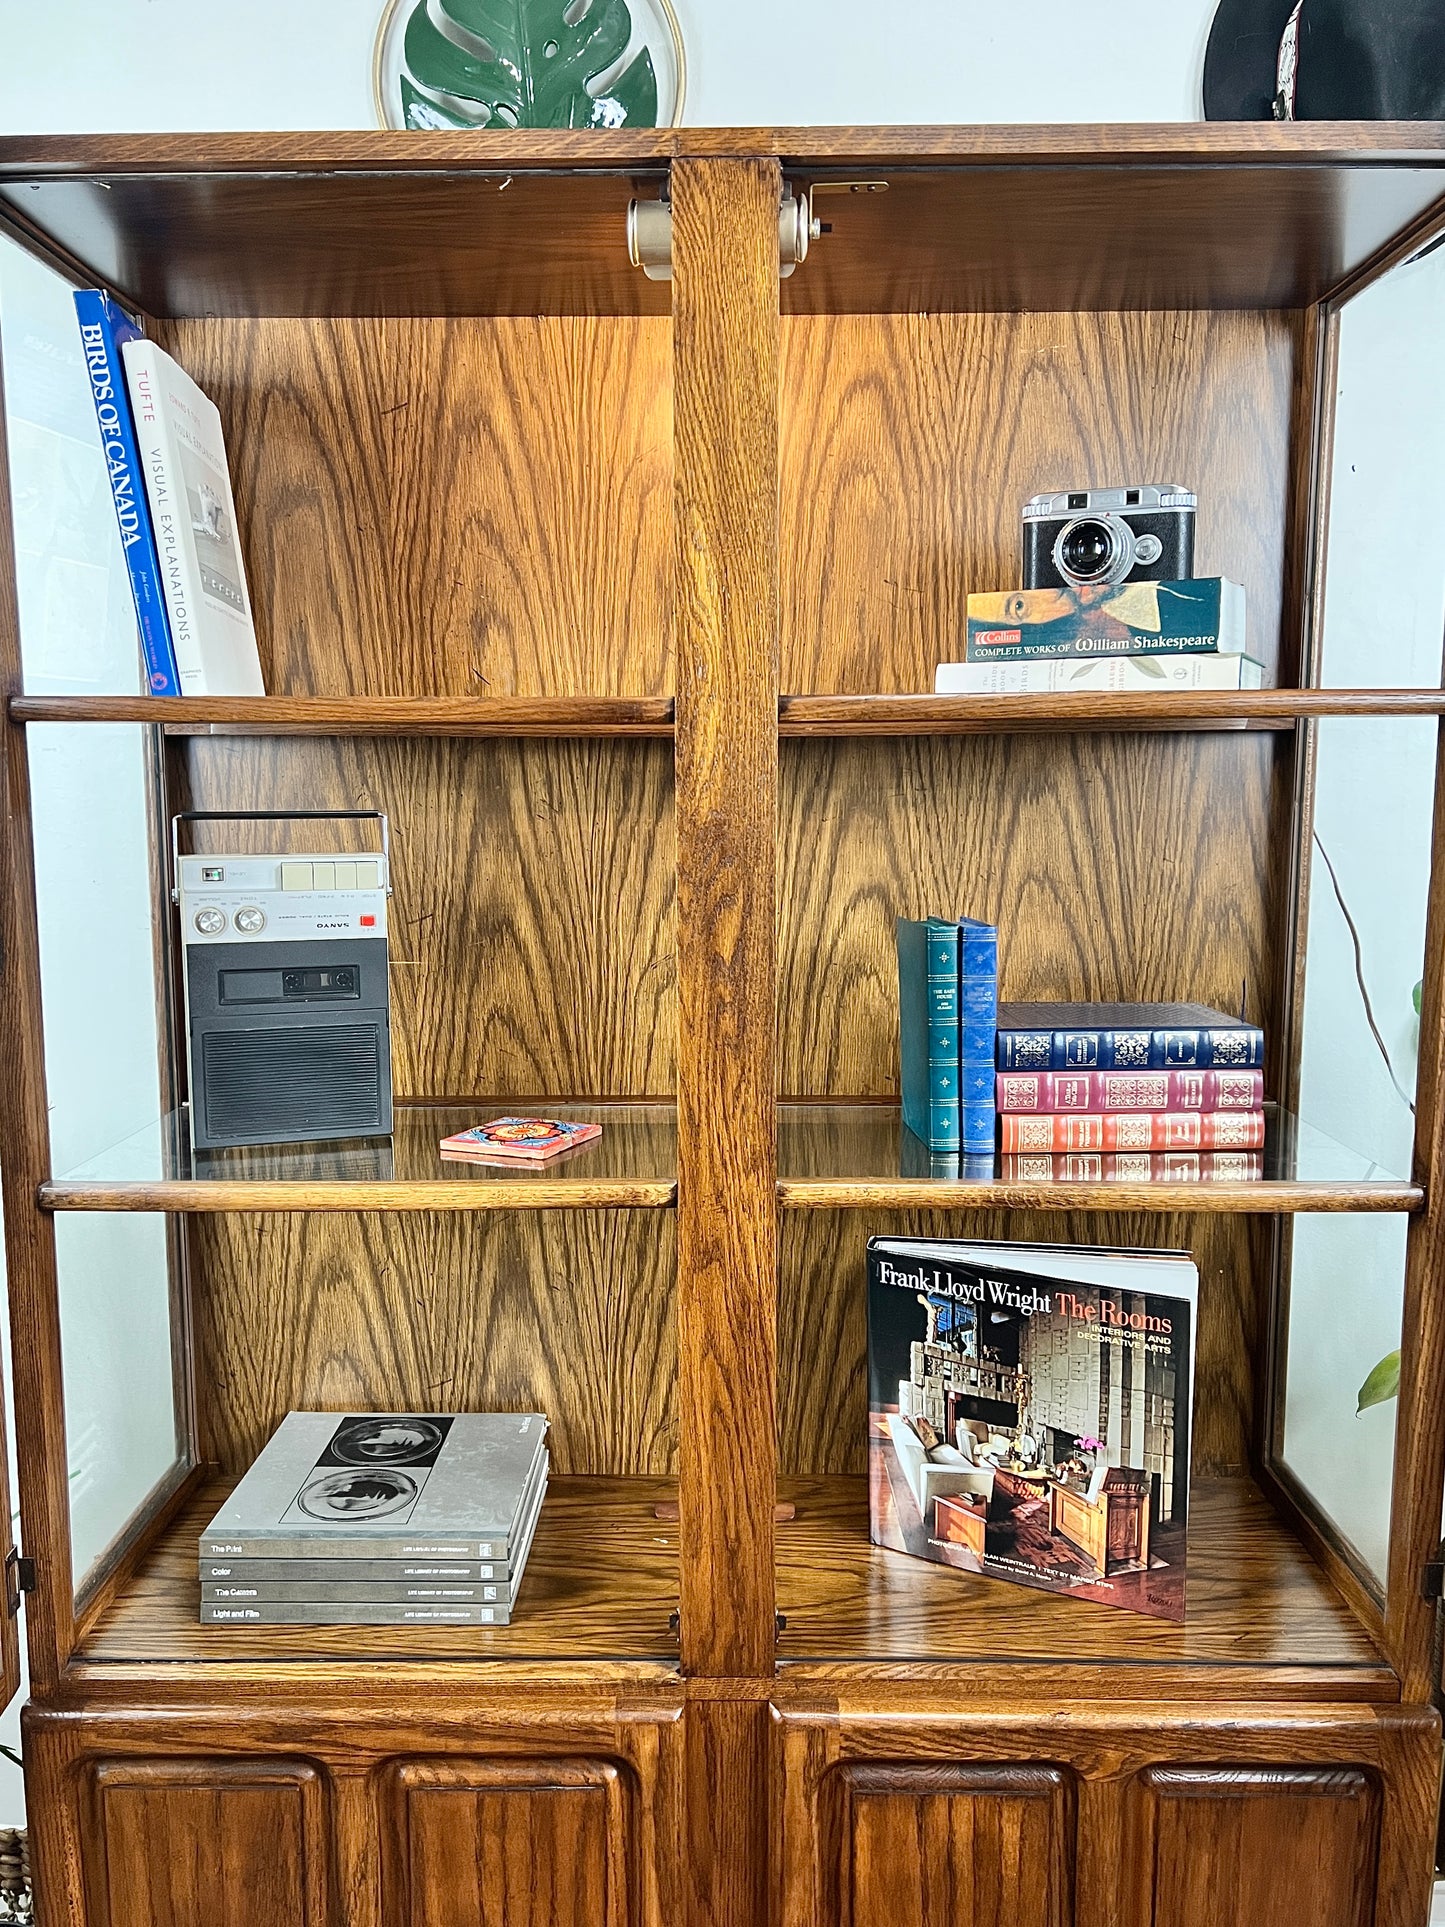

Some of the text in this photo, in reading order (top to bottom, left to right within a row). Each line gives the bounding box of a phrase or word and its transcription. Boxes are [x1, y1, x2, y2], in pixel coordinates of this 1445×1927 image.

[81, 322, 142, 550] BIRDS OF CANADA
[136, 369, 191, 642] TUFTE VISUAL EXPLANATIONS
[975, 634, 1215, 657] COMPLETE WORKS OF William Shakespeare
[987, 632, 1019, 644] Collins
[879, 1261, 1172, 1335] Frank Lloyd Wright The Rooms
[1077, 1331, 1171, 1355] DECORATIVE ARTS
[1091, 1324, 1171, 1345] INTERIORS AND
[983, 1552, 999, 1562] ALAN
[211, 1568, 232, 1576] Color
[213, 1609, 231, 1618] Light
